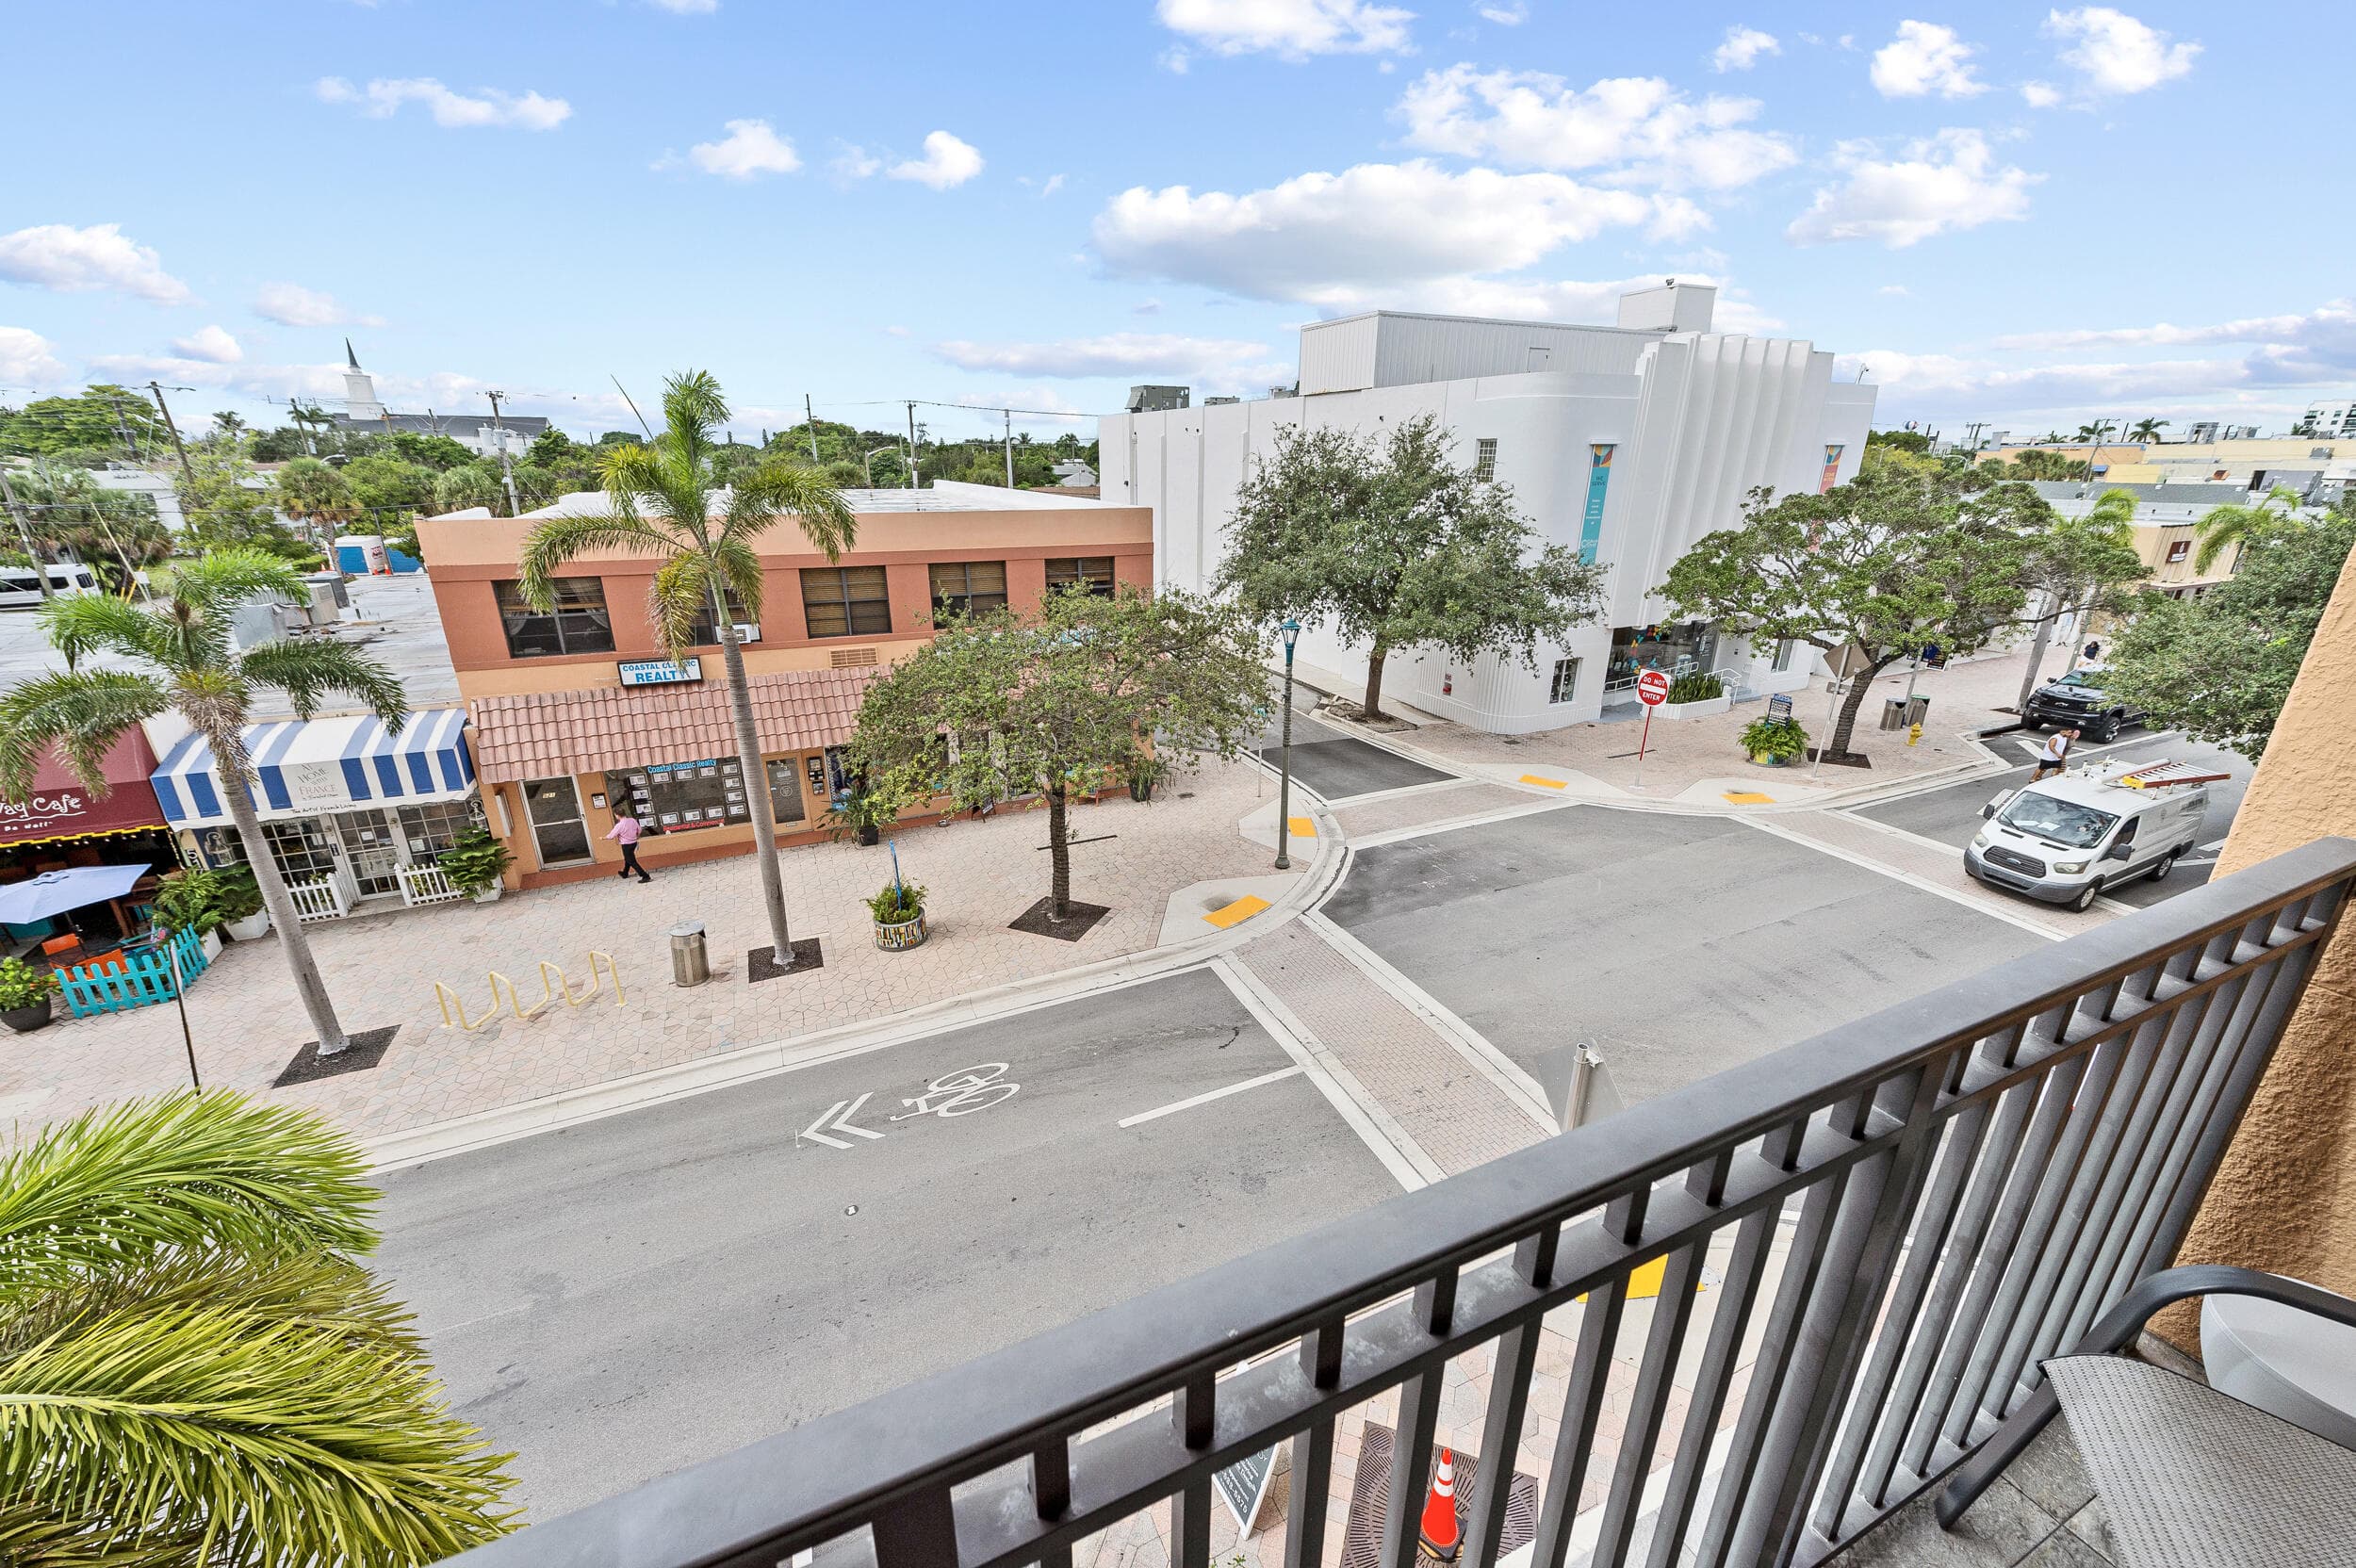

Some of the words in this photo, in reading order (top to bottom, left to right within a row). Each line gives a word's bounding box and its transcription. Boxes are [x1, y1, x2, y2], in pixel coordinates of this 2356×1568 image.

[622, 663, 660, 672] COASTAL
[662, 661, 696, 669] CLIC
[1643, 675, 1652, 684] DO
[1654, 678, 1666, 687] NOT
[1642, 691, 1661, 701] ENTER
[648, 765, 671, 774] Coastal
[673, 760, 695, 771] Classic
[696, 759, 716, 768] Realty
[298, 768, 328, 783] HOME
[299, 784, 337, 795] FRANCE
